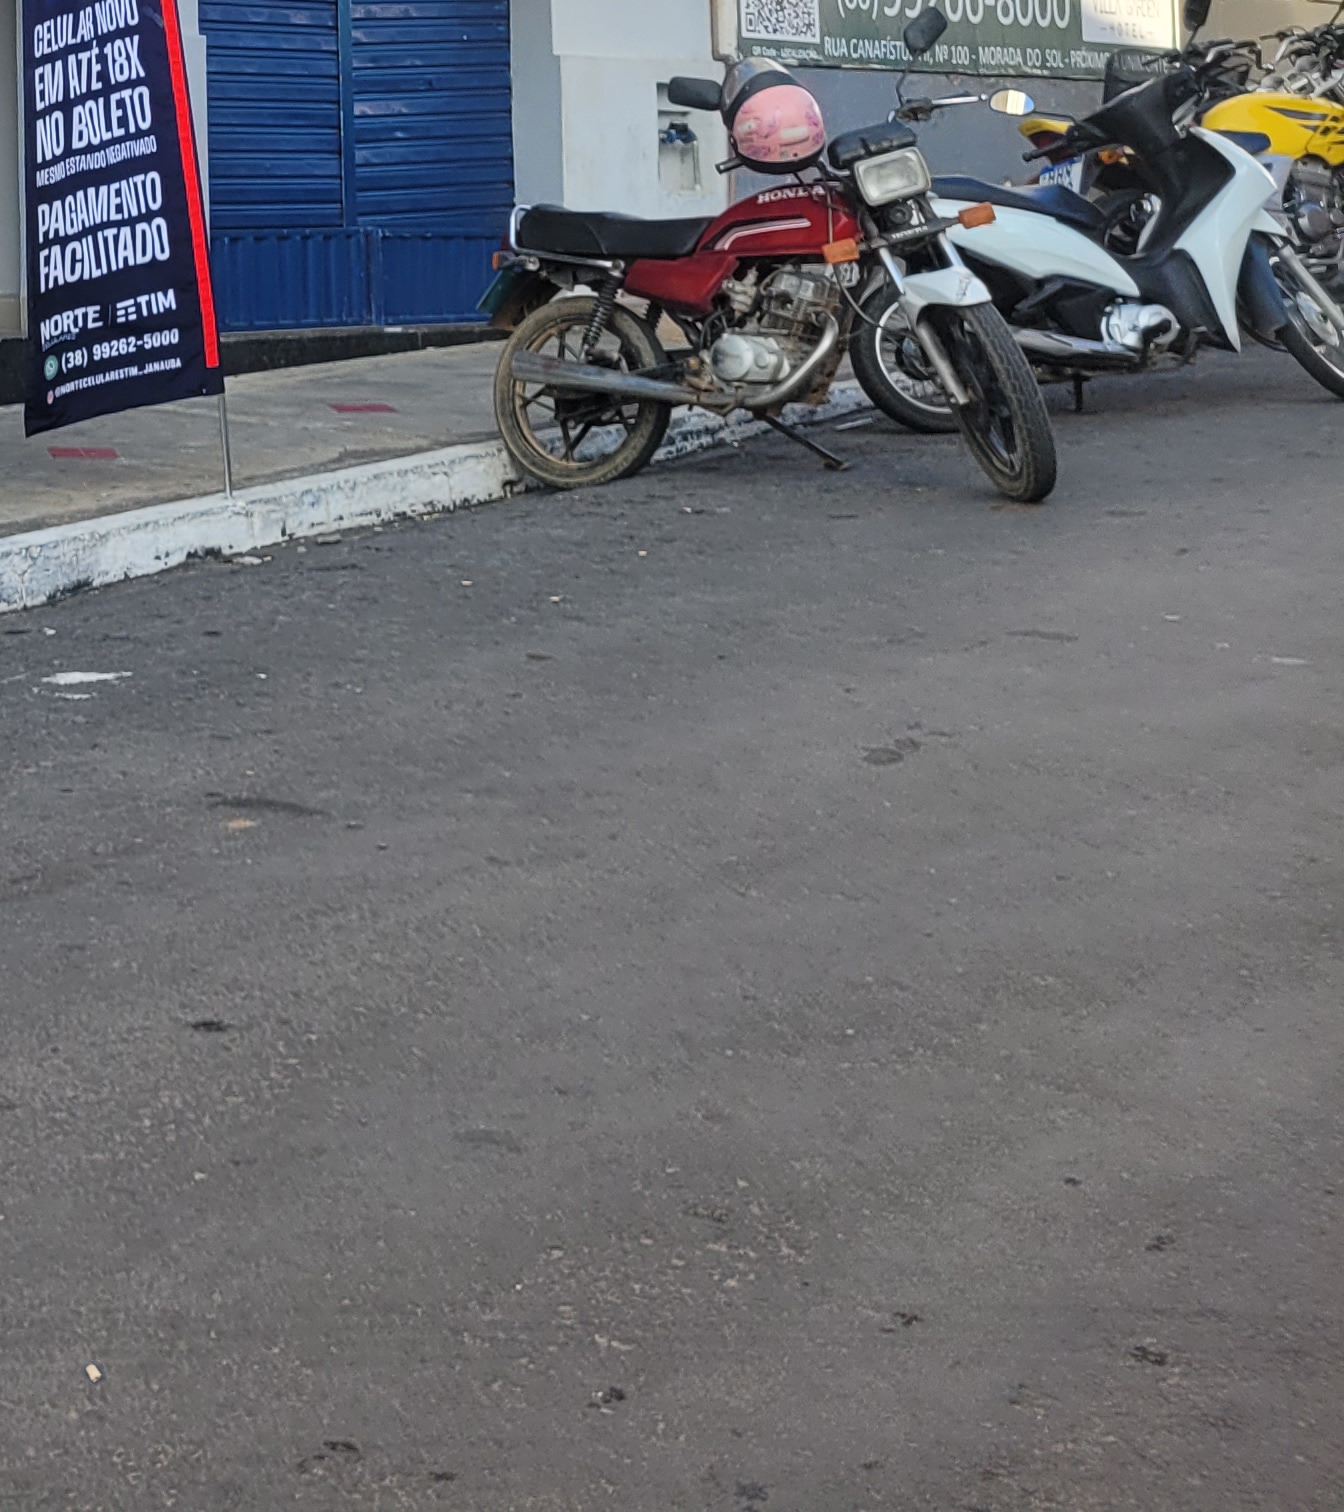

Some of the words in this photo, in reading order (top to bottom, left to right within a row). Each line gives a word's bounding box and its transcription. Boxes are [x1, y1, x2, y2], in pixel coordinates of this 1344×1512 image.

[34, 8, 96, 59] CELULAR
[824, 36, 848, 58] RUA
[850, 35, 922, 62] CANAFÍSTU
[950, 45, 969, 65] 100
[978, 45, 1022, 66] MORADA
[1026, 47, 1042, 67] DO
[1045, 48, 1064, 68] SOL
[34, 59, 64, 111] EM
[68, 39, 103, 99] ATÉ
[103, 34, 146, 89] 18X
[35, 109, 64, 164] NO
[71, 85, 152, 150] BOLETO
[36, 161, 66, 188] MESMO
[65, 149, 106, 176] ESTANDO
[106, 135, 157, 166] NEGATIVADO
[37, 171, 162, 244] PAGAMENTO
[39, 216, 170, 294] FACILITADO
[40, 304, 104, 346] NORTE
[137, 288, 177, 318] TIM
[61, 347, 88, 374] (38)
[92, 328, 180, 361] 99262-5000
